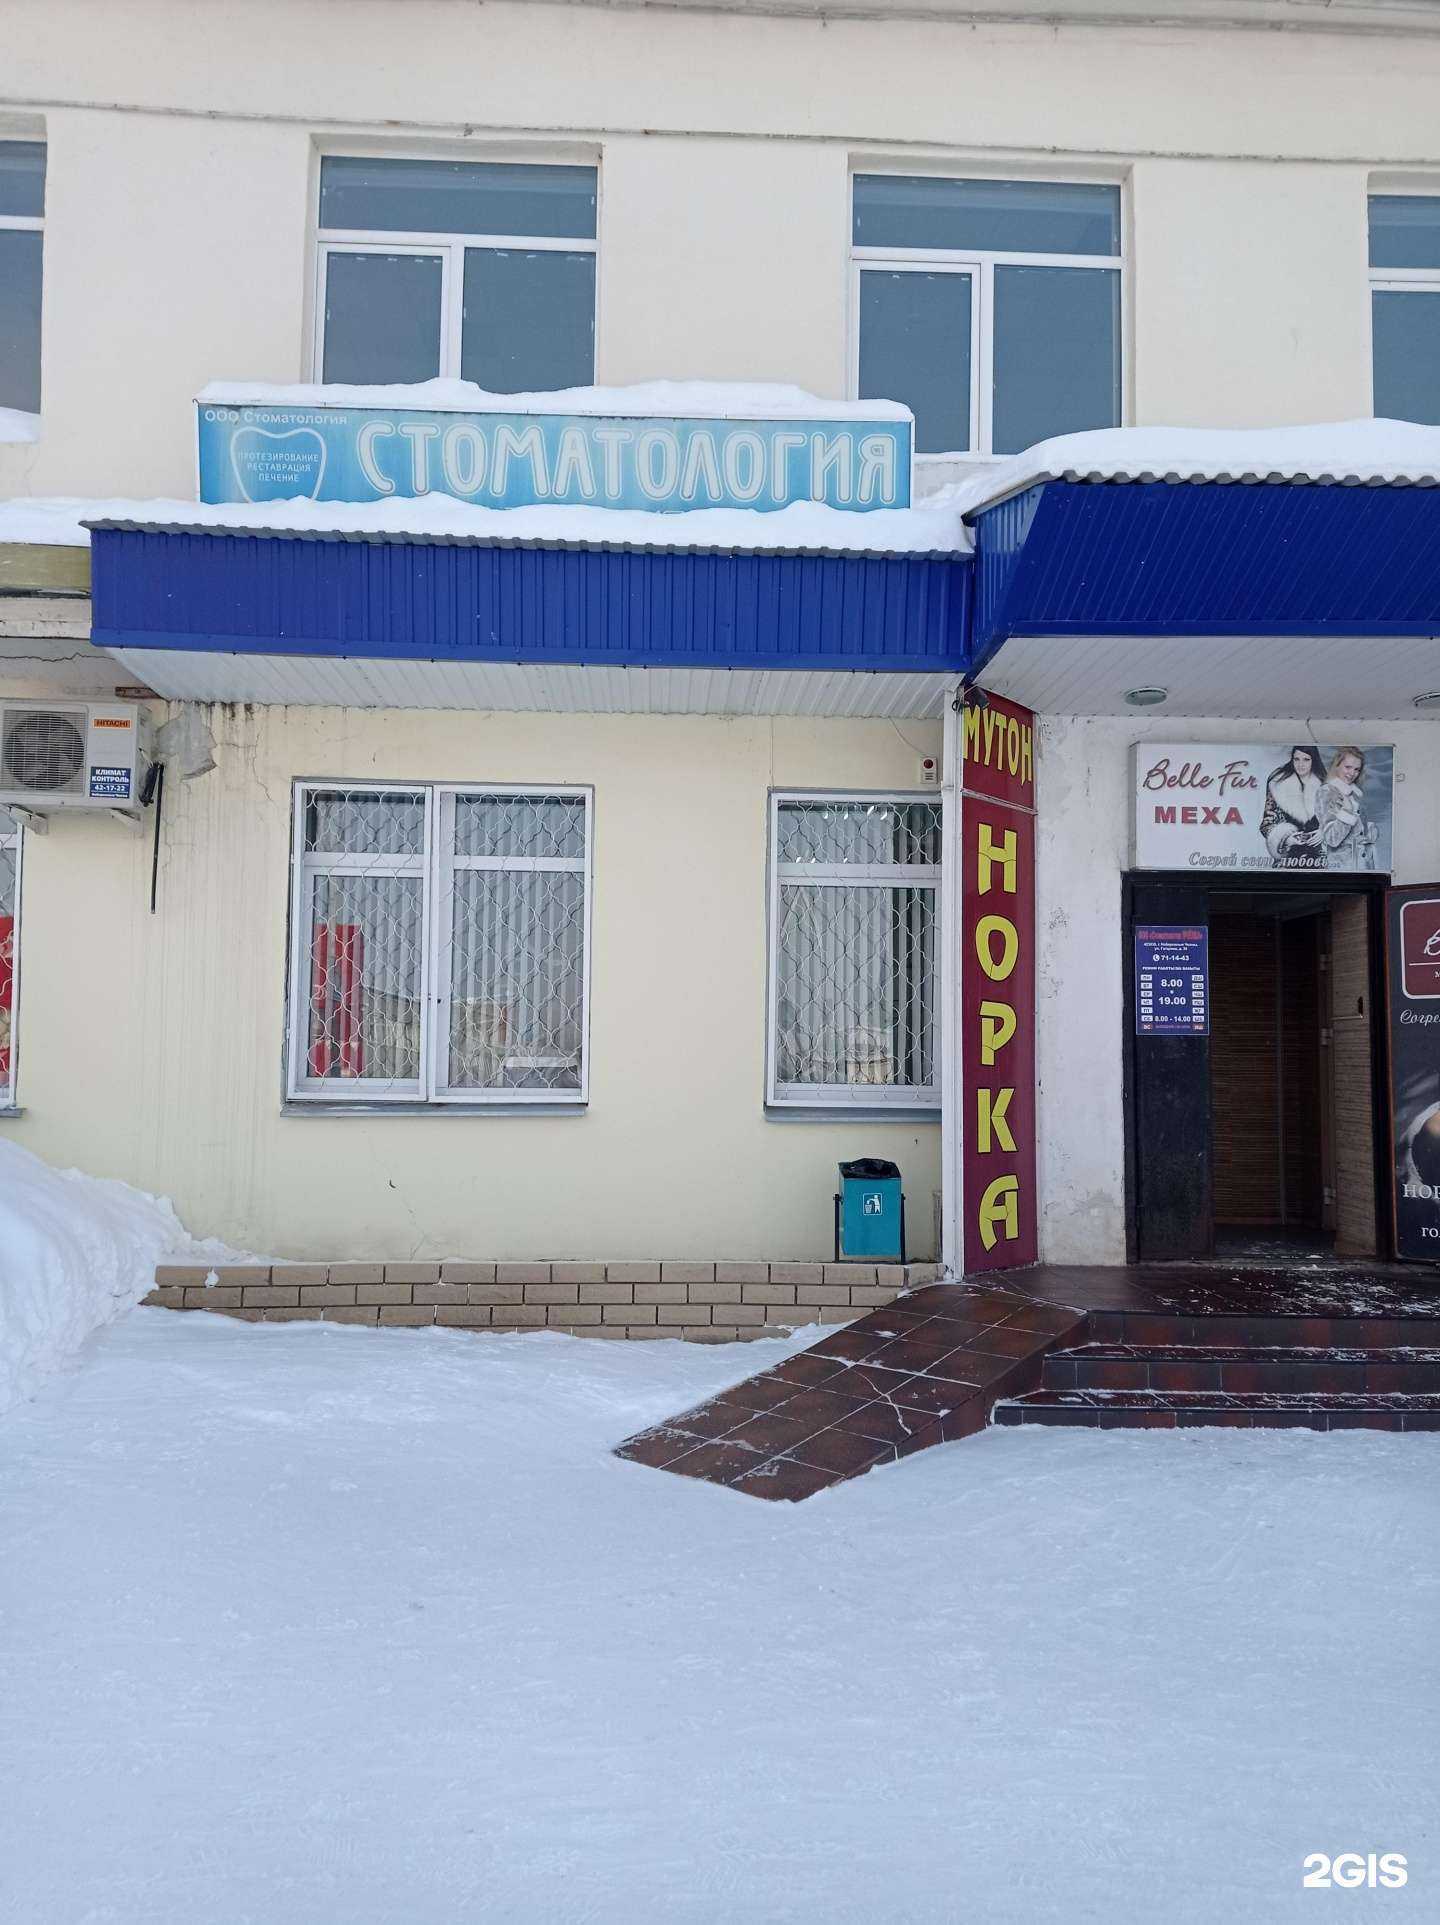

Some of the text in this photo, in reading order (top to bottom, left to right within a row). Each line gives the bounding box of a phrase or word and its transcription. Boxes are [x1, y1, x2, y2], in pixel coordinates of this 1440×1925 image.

[204, 410, 348, 425] ООО Стоматология
[238, 451, 319, 463] ПРОТЕЗИРОВАНИЕ
[356, 419, 897, 503] СТОМАТОЛОГИЯ
[247, 463, 312, 473] РЕСТАВРАЦИЯ
[95, 719, 130, 728] HITACHI
[962, 705, 1033, 785] МУТОН
[91, 775, 130, 783] КОНТРОЛЬ
[1142, 758, 1258, 796] Belle Fur
[1153, 805, 1245, 826] МЕХА
[1188, 851, 1238, 869] Согрей
[1160, 979, 1183, 987] 8.00
[1158, 996, 1187, 1005] 19.00
[1400, 1008, 1440, 1027] Согре
[974, 822, 1020, 1253] НОРКА
